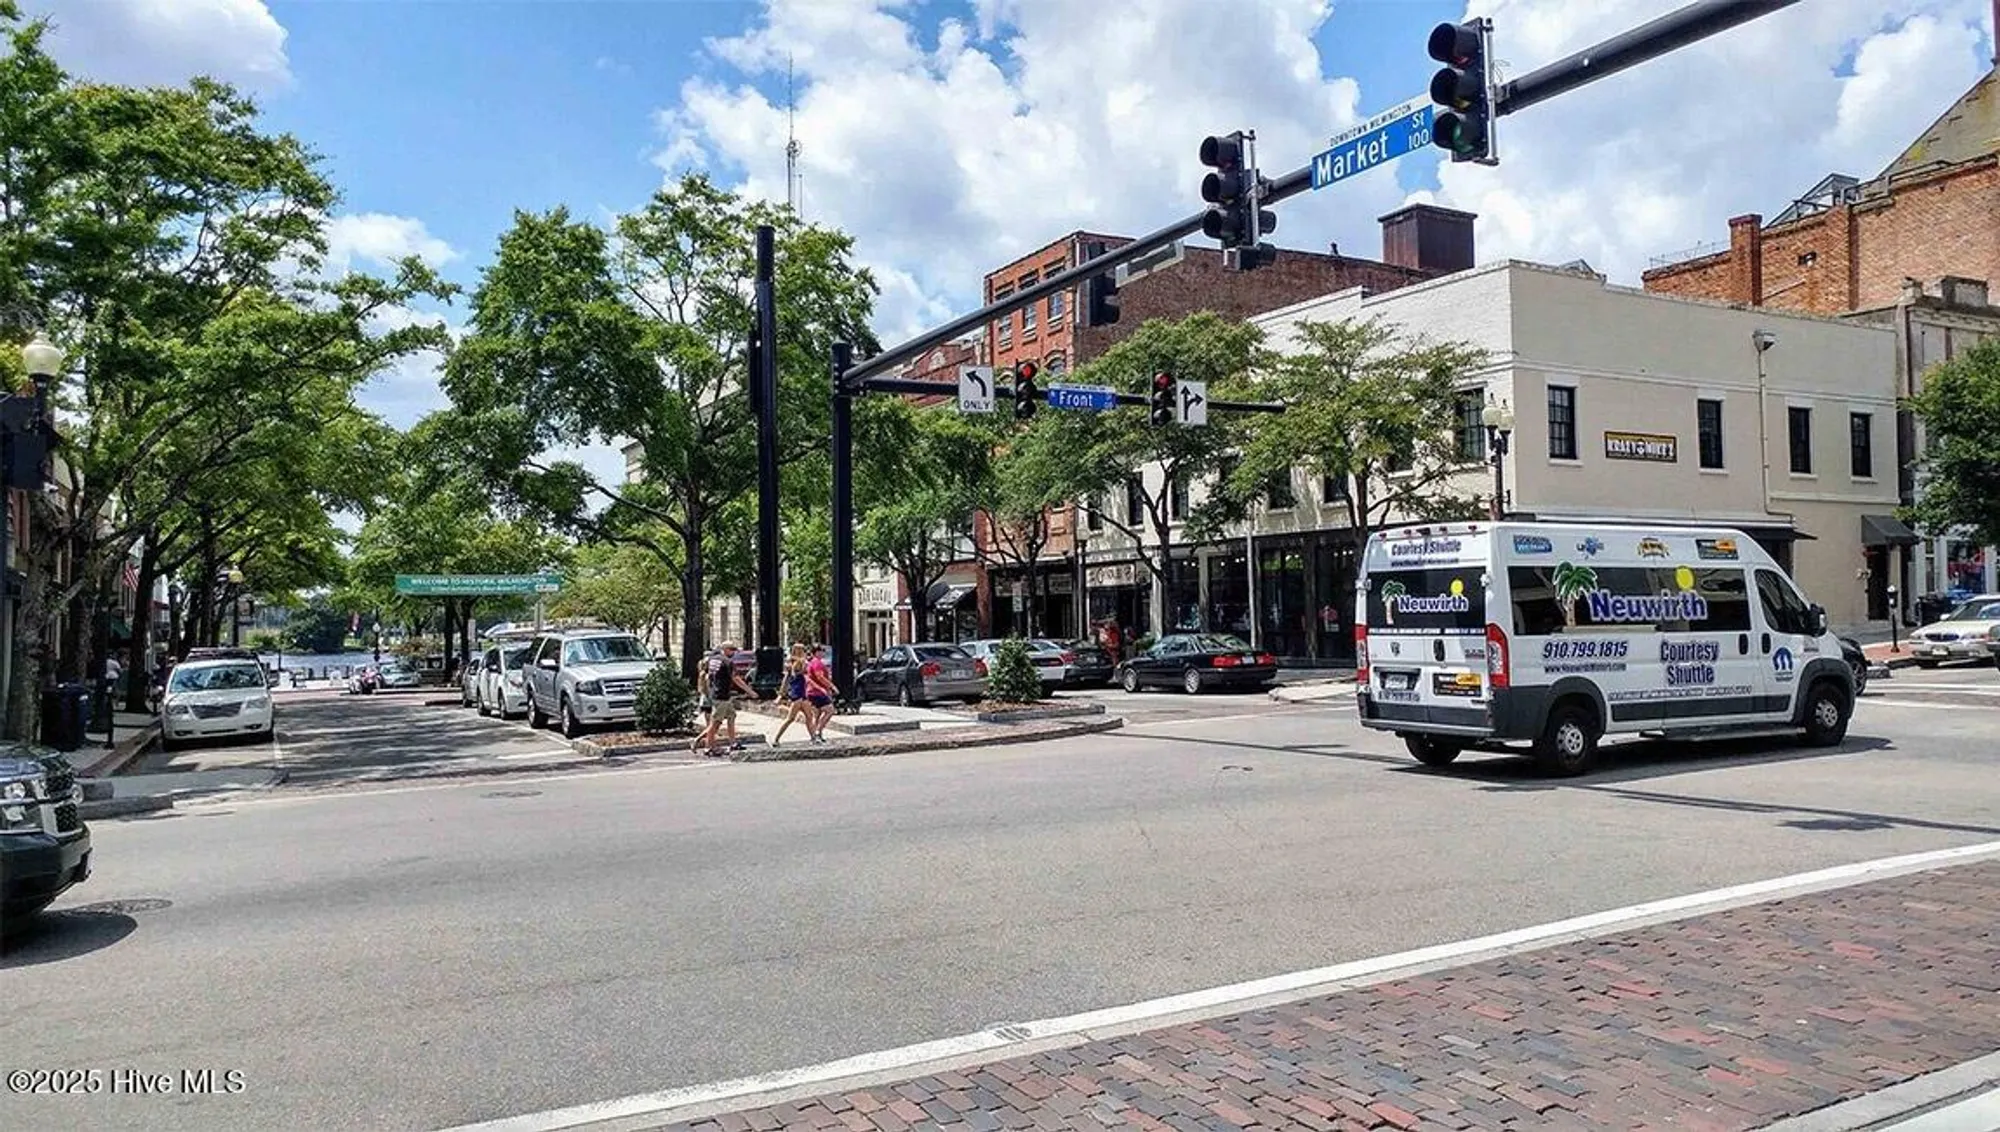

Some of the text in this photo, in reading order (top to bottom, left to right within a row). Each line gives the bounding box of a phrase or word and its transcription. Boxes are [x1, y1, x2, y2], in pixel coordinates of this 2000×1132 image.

[1316, 111, 1425, 186] Market St
[1407, 128, 1429, 150] 100
[963, 401, 990, 410] ONLY
[1059, 391, 1093, 407] Front
[1391, 539, 1462, 557] Courtesy Shuttle
[411, 577, 449, 586] WELCOME
[1398, 595, 1469, 613] Neuwirth
[1589, 589, 1708, 621] Neuwirth
[1543, 640, 1628, 659] 910.799.1815
[1659, 640, 1721, 664] Courtesy
[1666, 664, 1716, 686] Shuttle
